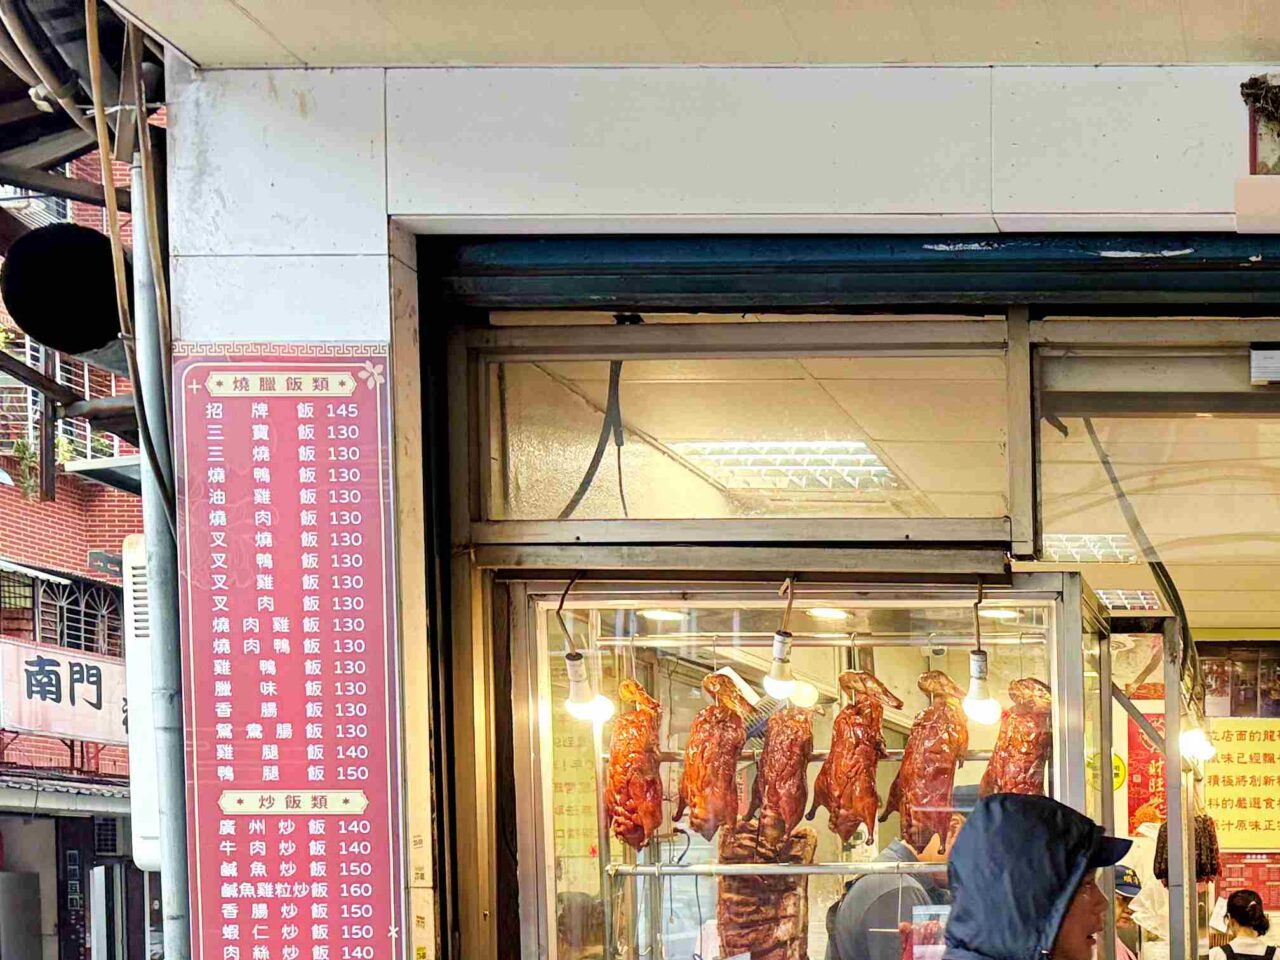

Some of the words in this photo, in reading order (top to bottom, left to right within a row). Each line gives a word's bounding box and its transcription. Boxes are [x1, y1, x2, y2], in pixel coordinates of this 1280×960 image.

[232, 376, 330, 392] 燒臘飯類
[206, 403, 313, 418] 招牌飯
[327, 404, 357, 417] 145
[207, 424, 314, 440] 三寶飯
[328, 426, 358, 438] 130
[208, 446, 315, 461] 三燒飯
[329, 447, 359, 460] 130
[208, 467, 316, 483] 燒鴨飯
[329, 469, 360, 481] 130
[209, 489, 316, 504] 油雞飯
[330, 490, 360, 503] 130
[209, 510, 317, 526] 燒肉飯
[331, 512, 361, 524] 130
[24, 654, 103, 711] 南門
